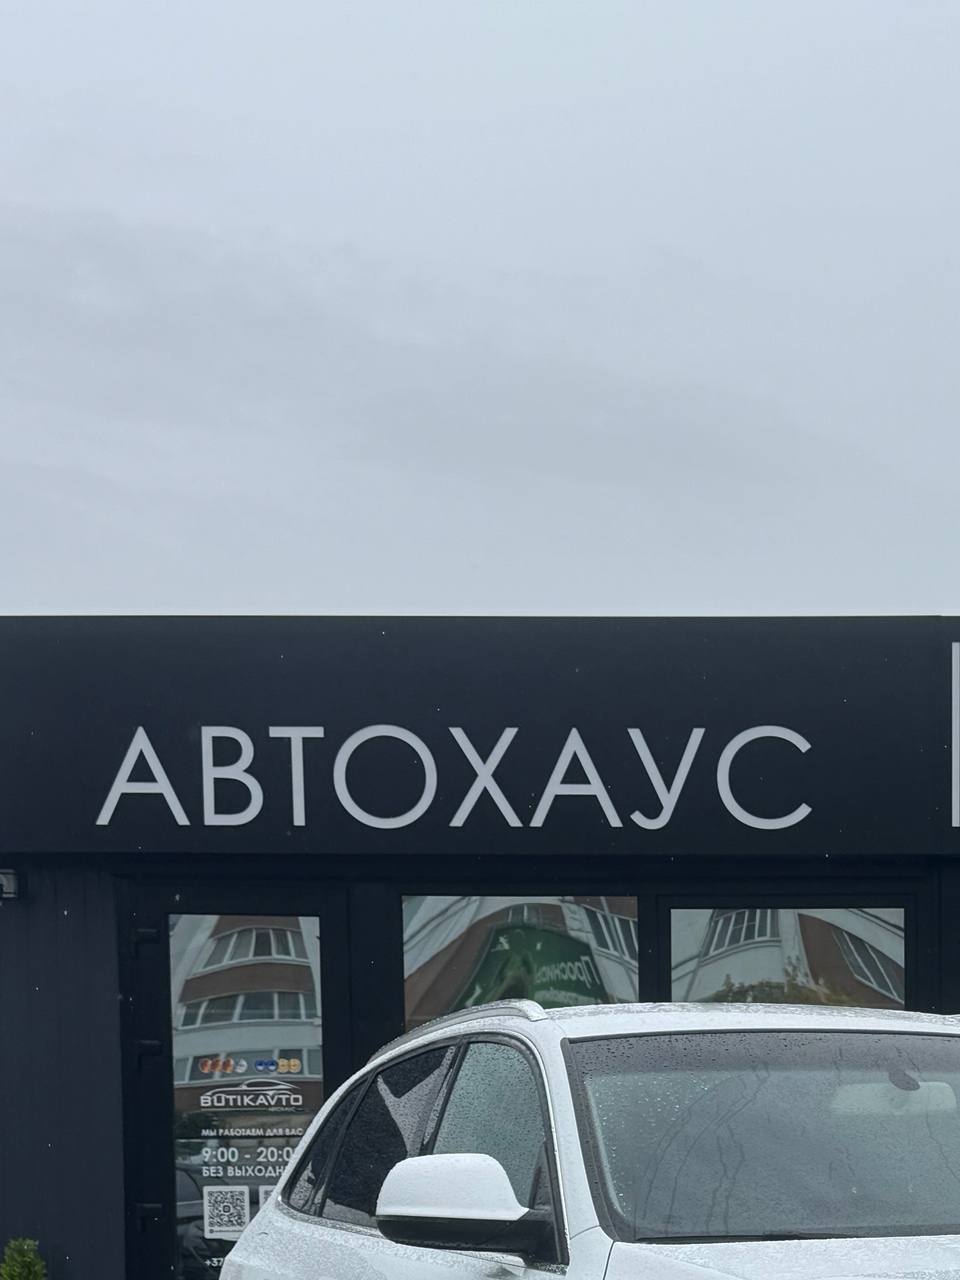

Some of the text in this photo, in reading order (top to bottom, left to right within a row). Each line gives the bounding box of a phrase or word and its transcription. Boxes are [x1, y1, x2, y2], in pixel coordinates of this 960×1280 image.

[96, 724, 812, 830] АВТОХАУС
[200, 1094, 303, 1107] BUTIKAVTO
[202, 1147, 239, 1162] 9:00
[256, 1147, 296, 1162] 20:0
[202, 1165, 286, 1178] БЕЗ ВЫХОДН
